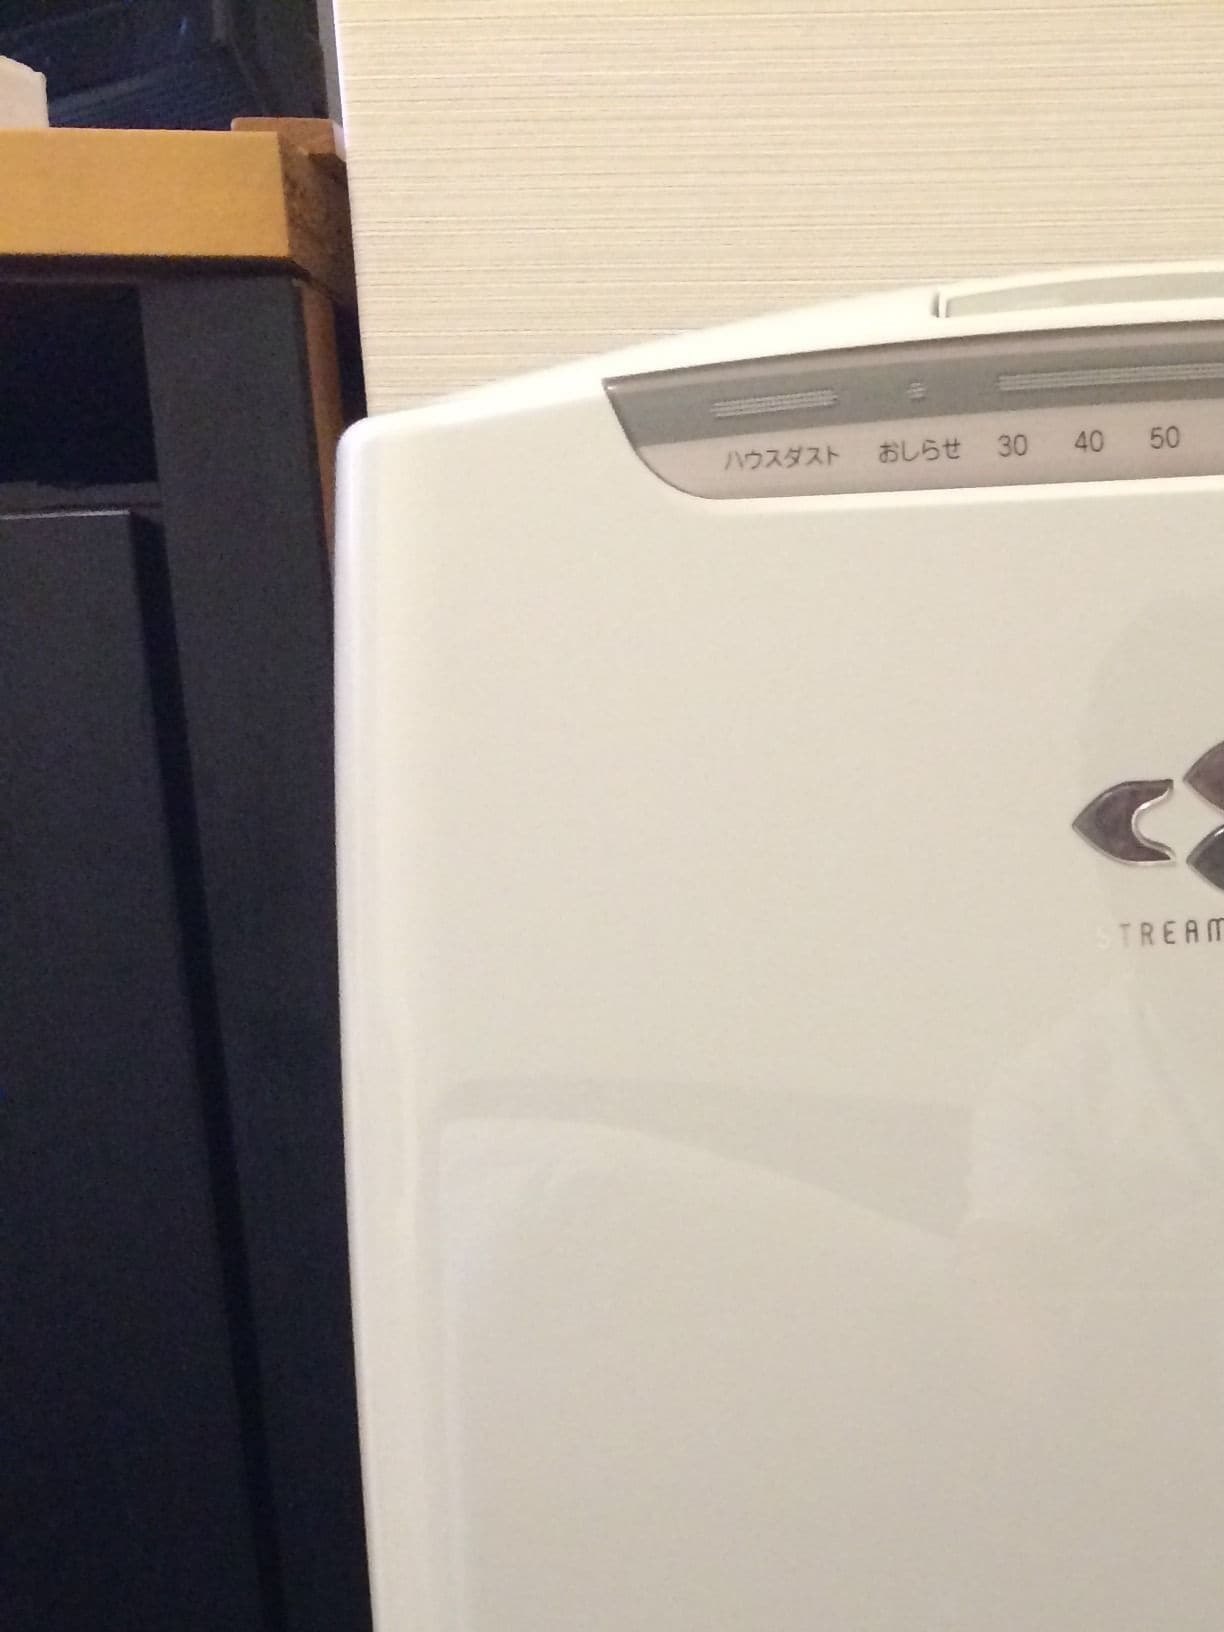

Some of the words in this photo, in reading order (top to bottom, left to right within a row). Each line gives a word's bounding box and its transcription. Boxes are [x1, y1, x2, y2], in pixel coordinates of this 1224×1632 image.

[878, 437, 962, 464] おしらせ
[997, 433, 1029, 458] 30
[1074, 430, 1105, 453] 40
[1150, 426, 1181, 449] 50
[723, 446, 840, 471] ハウスダスト
